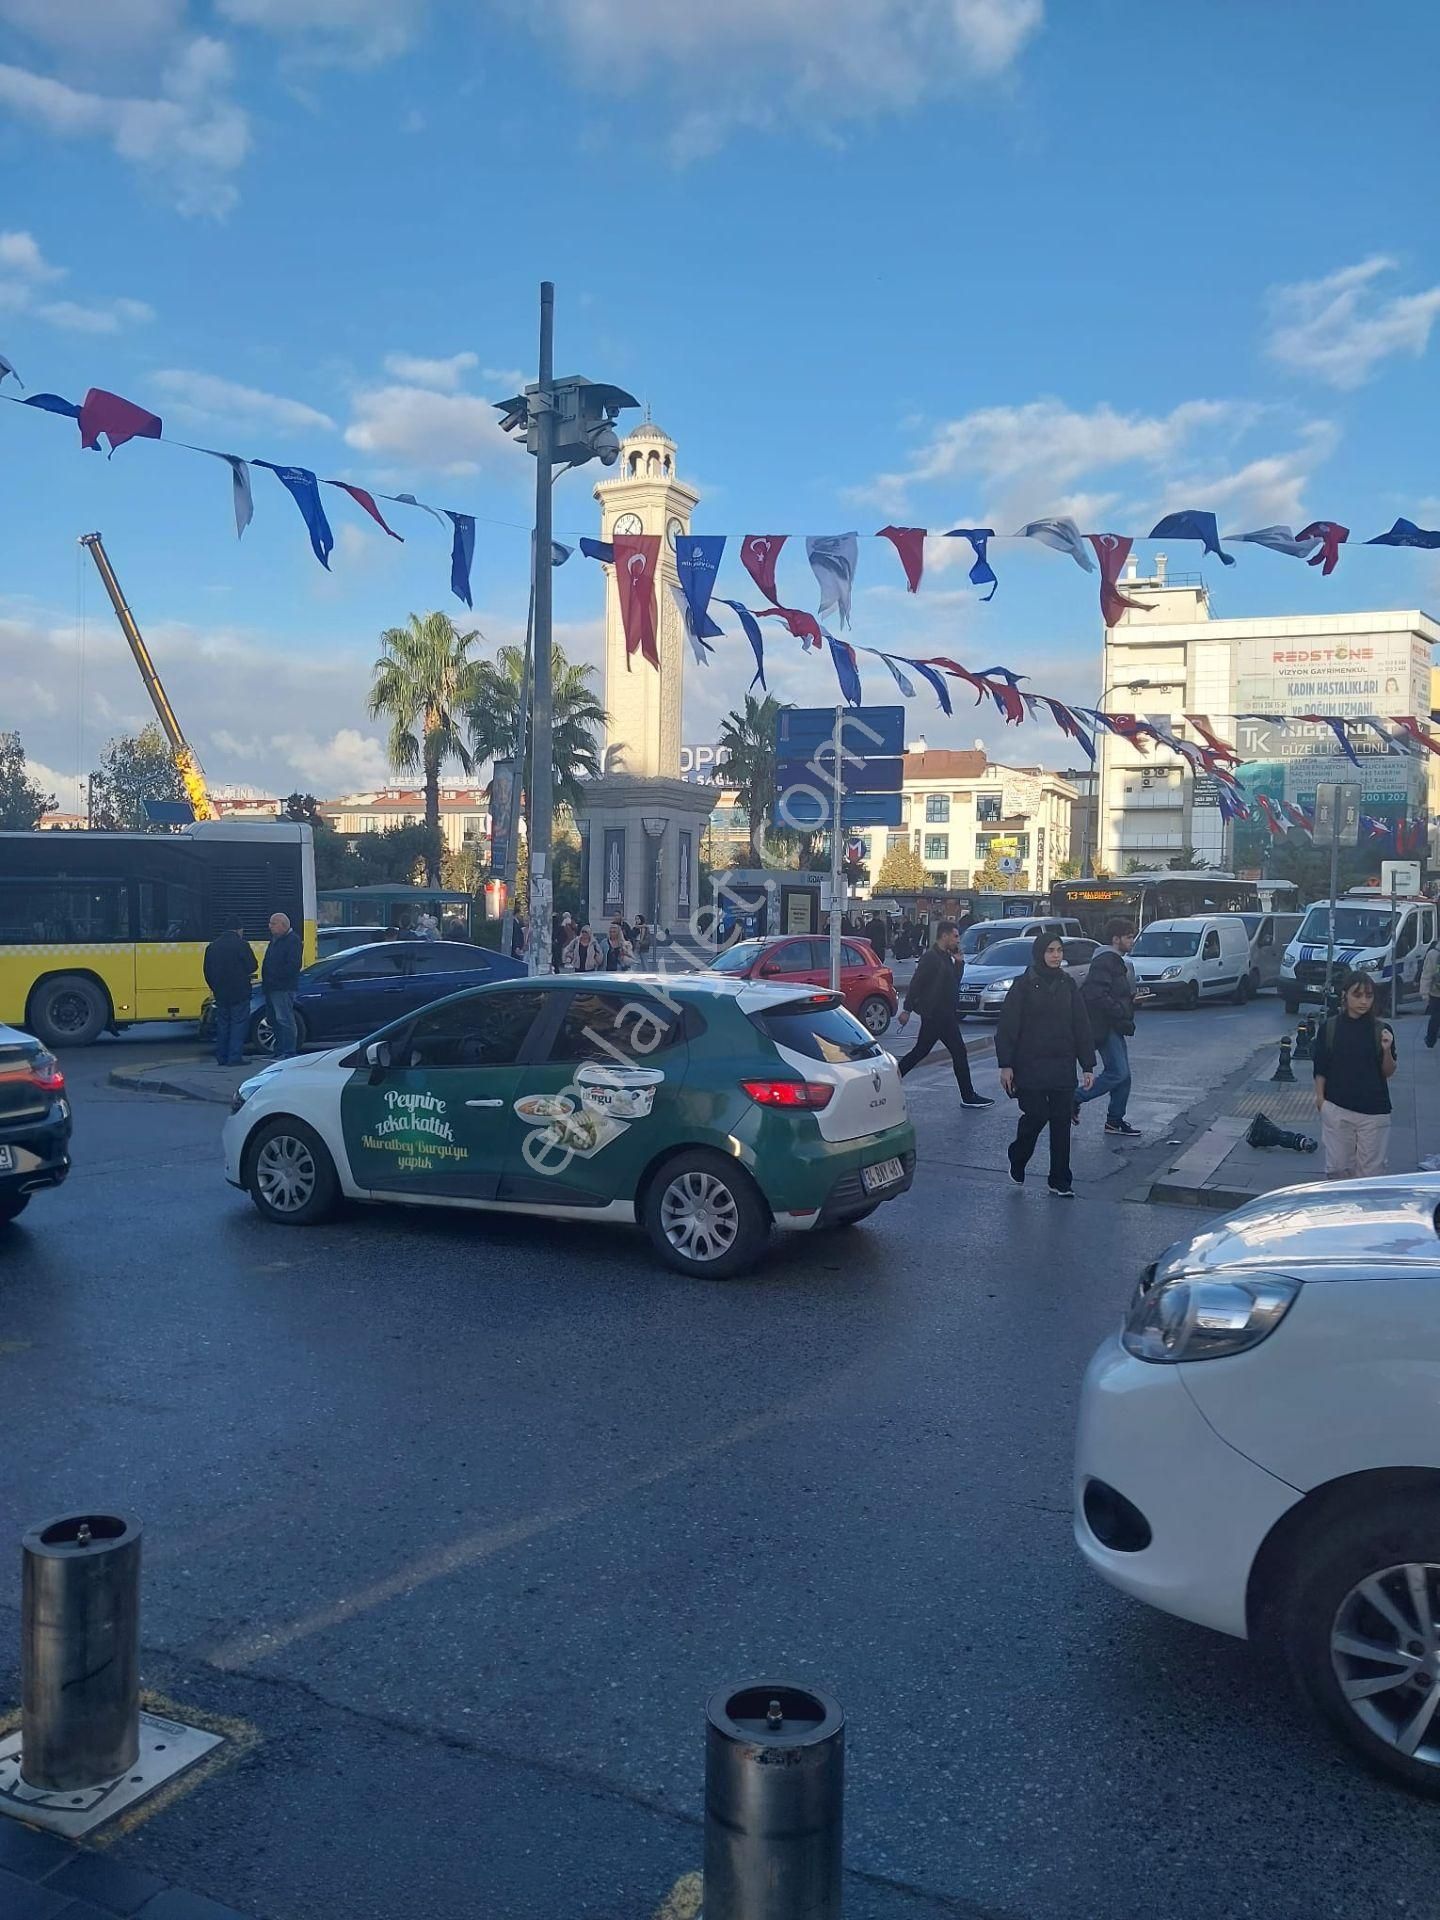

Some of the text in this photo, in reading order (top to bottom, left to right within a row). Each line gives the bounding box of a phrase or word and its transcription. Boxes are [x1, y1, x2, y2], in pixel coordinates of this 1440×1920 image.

[1273, 647, 1374, 663] REDSTONE
[1288, 680, 1378, 696] KADIN HASTALIKLARI
[1304, 702, 1337, 715] DOĞUM
[1339, 701, 1373, 714] UZMANI
[1239, 727, 1271, 753] TK
[384, 1091, 447, 1114] Peynire
[870, 1098, 887, 1108] CLIO
[376, 1113, 456, 1143] zeka kattık
[362, 1135, 415, 1156] Muratbey
[398, 1156, 433, 1171] yaptık
